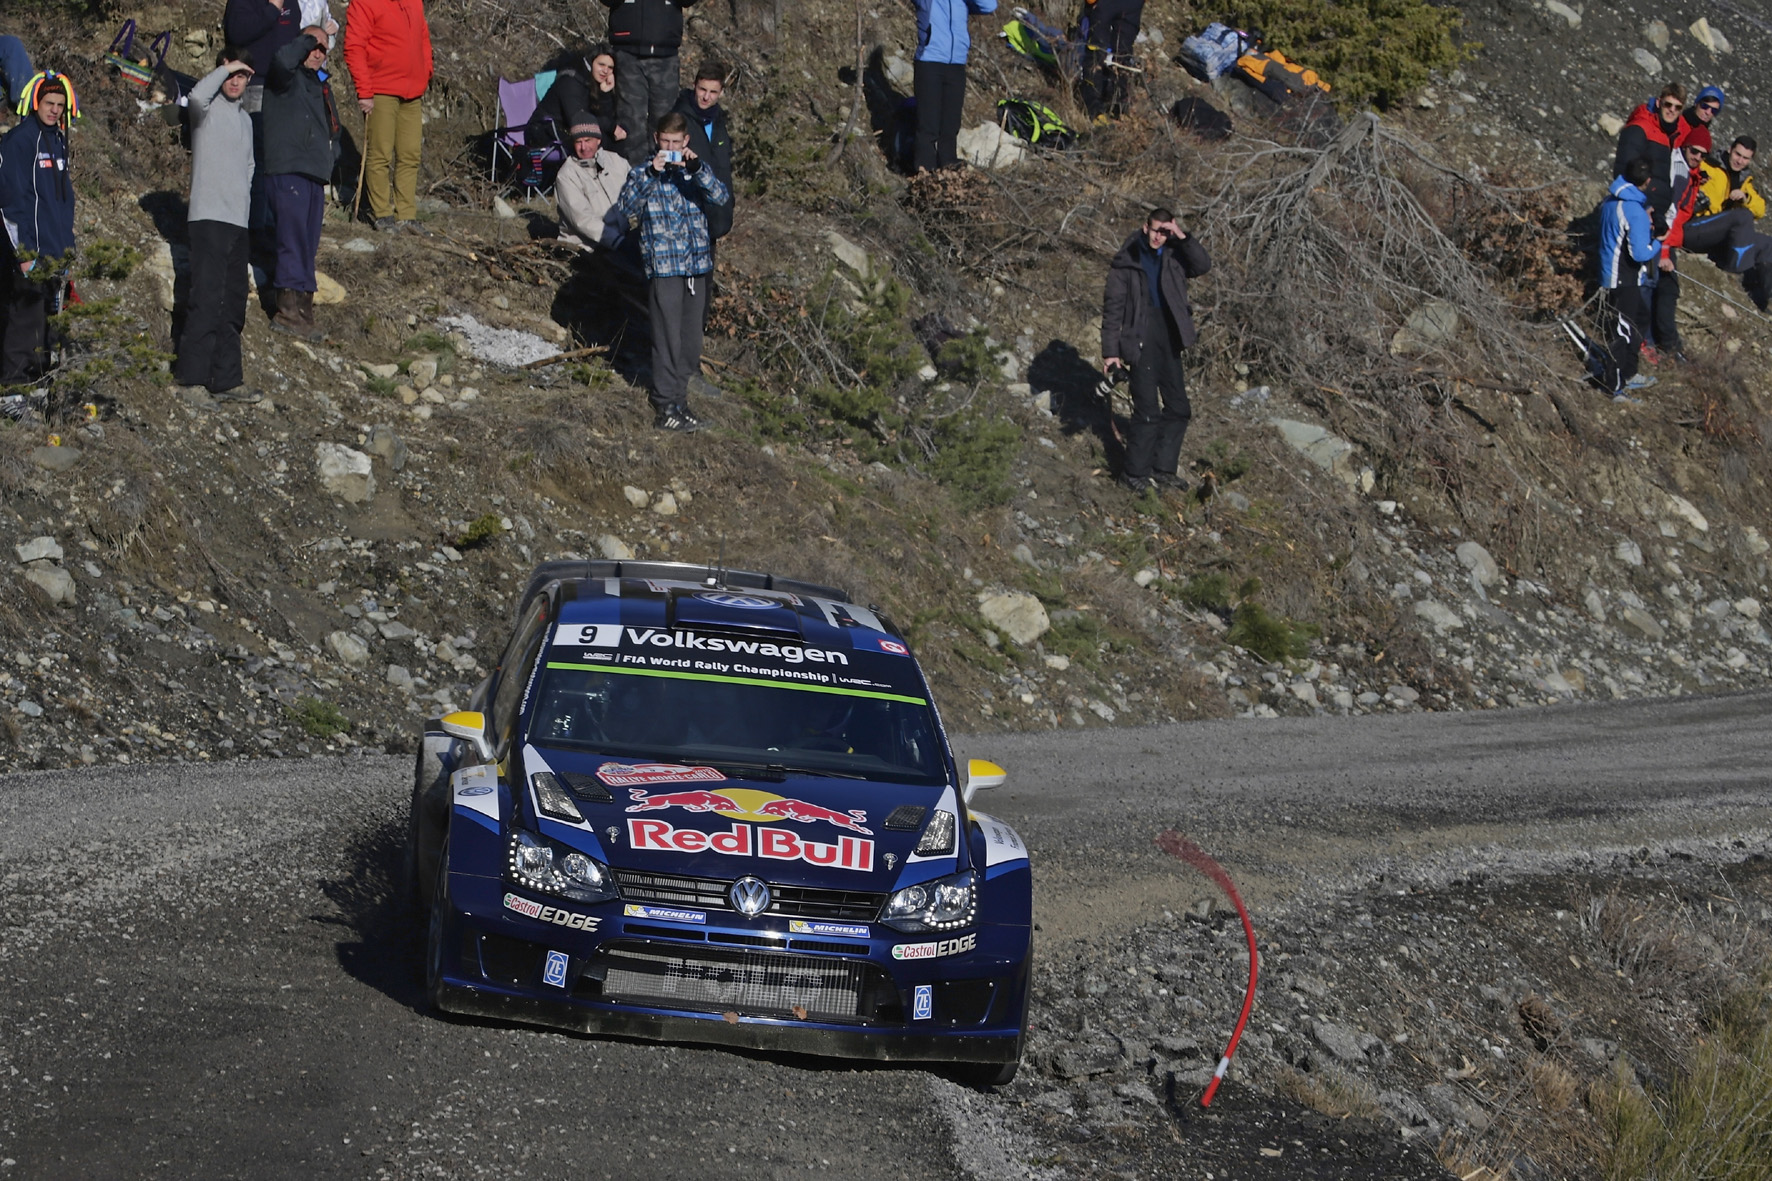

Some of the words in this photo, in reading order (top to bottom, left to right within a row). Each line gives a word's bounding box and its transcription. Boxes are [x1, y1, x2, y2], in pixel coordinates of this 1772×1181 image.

[578, 625, 598, 644] 9
[626, 628, 849, 665] Volkswagen
[622, 655, 646, 665] FIA
[650, 657, 691, 668] World
[694, 661, 730, 672] Rally
[733, 664, 829, 683] Championship
[605, 774, 647, 785] RALLYE
[647, 769, 721, 781] MONTE-CARLO
[628, 819, 751, 856] Red
[758, 827, 874, 871] Bull
[510, 896, 540, 916] Castrol
[539, 906, 602, 932] EDGE
[648, 908, 704, 921] MICHELIN
[813, 924, 868, 935] MICHELIN
[903, 944, 936, 958] Castrol
[937, 933, 976, 957] EDGE
